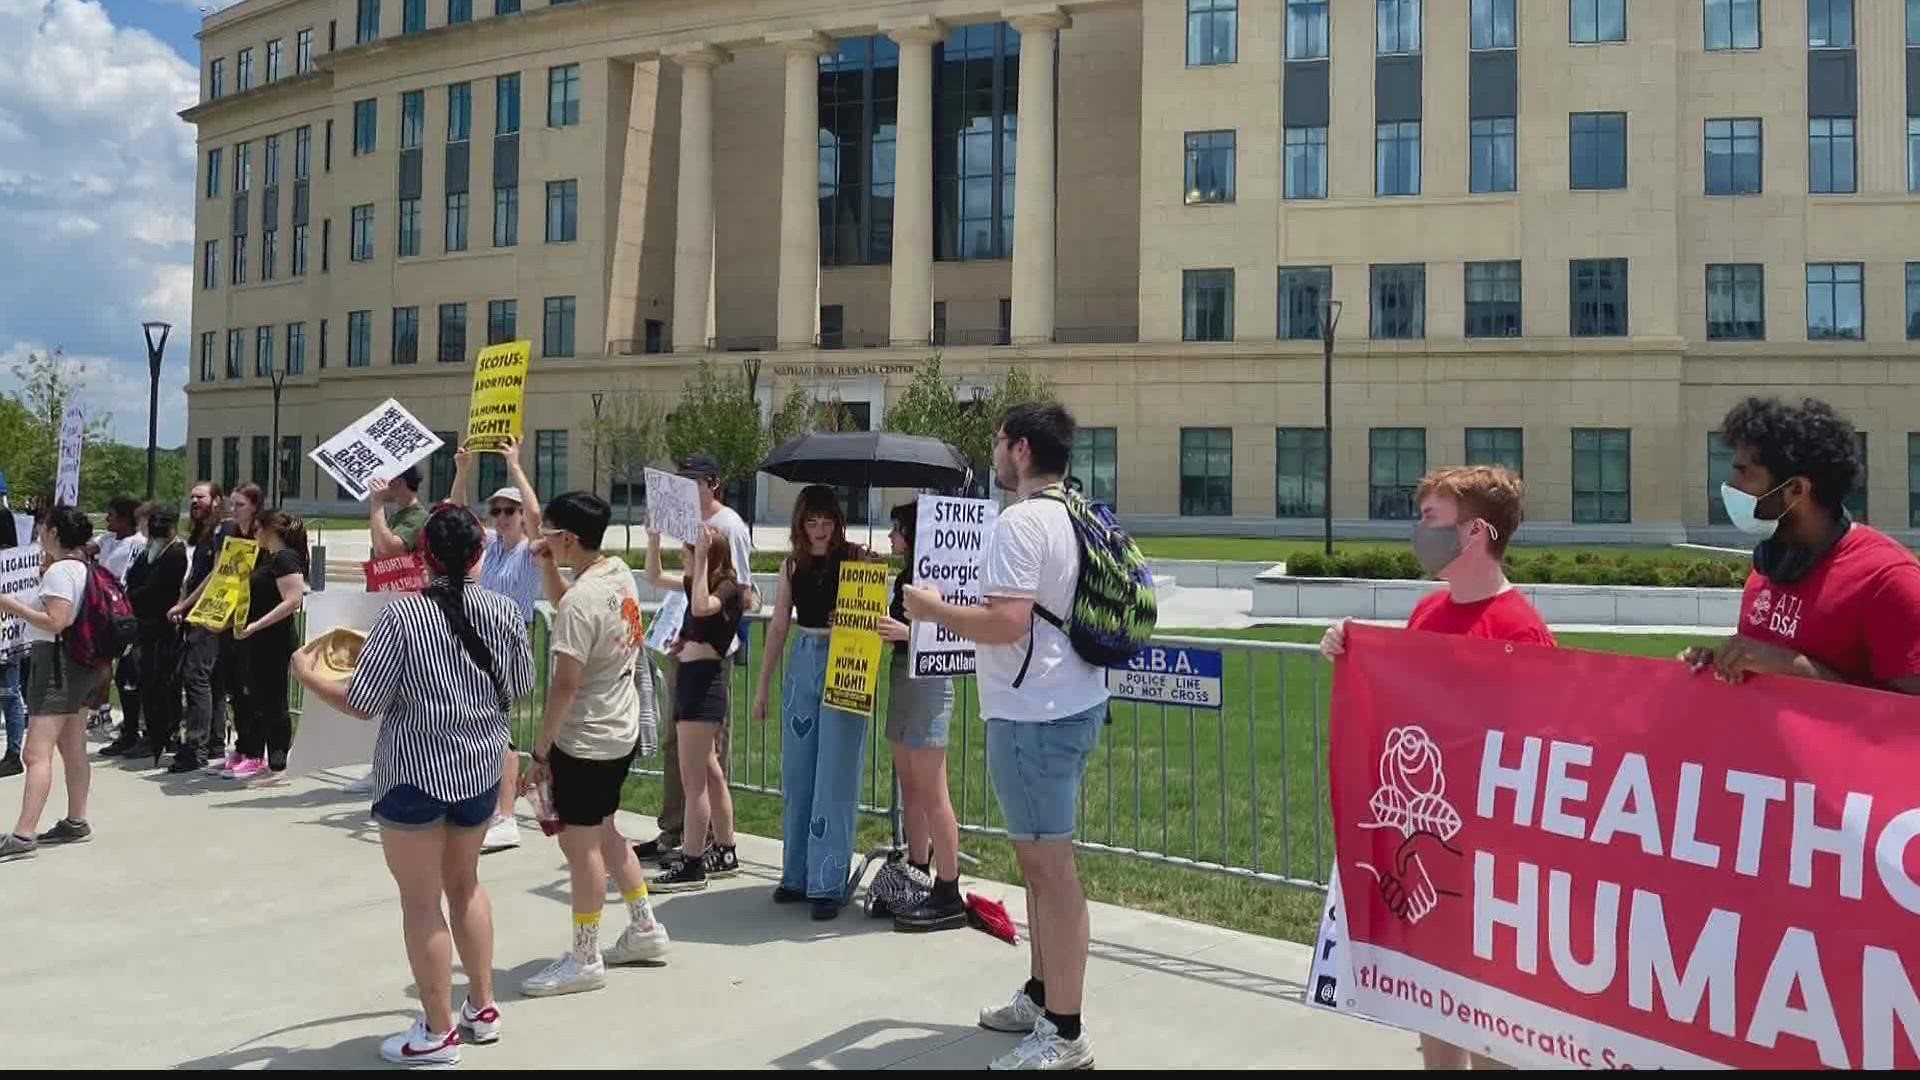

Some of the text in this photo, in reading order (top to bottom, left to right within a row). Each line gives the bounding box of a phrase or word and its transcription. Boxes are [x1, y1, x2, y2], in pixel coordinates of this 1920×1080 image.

[480, 351, 524, 372] SCOTUS:
[879, 364, 914, 376] CENTER
[480, 403, 517, 415] HUMAN
[935, 502, 985, 525] STRIKE
[934, 529, 982, 552] DOWN
[840, 567, 886, 586] ABORTION
[1774, 593, 1802, 620] ATL
[1769, 611, 1798, 638] DSA
[835, 655, 869, 672] HUMAN
[834, 671, 867, 692] RIGHT!
[1126, 673, 1201, 690] POLICE LINE
[1119, 684, 1210, 703] DO NOT CROSS
[1353, 963, 1594, 1068] tlanta Democratic
